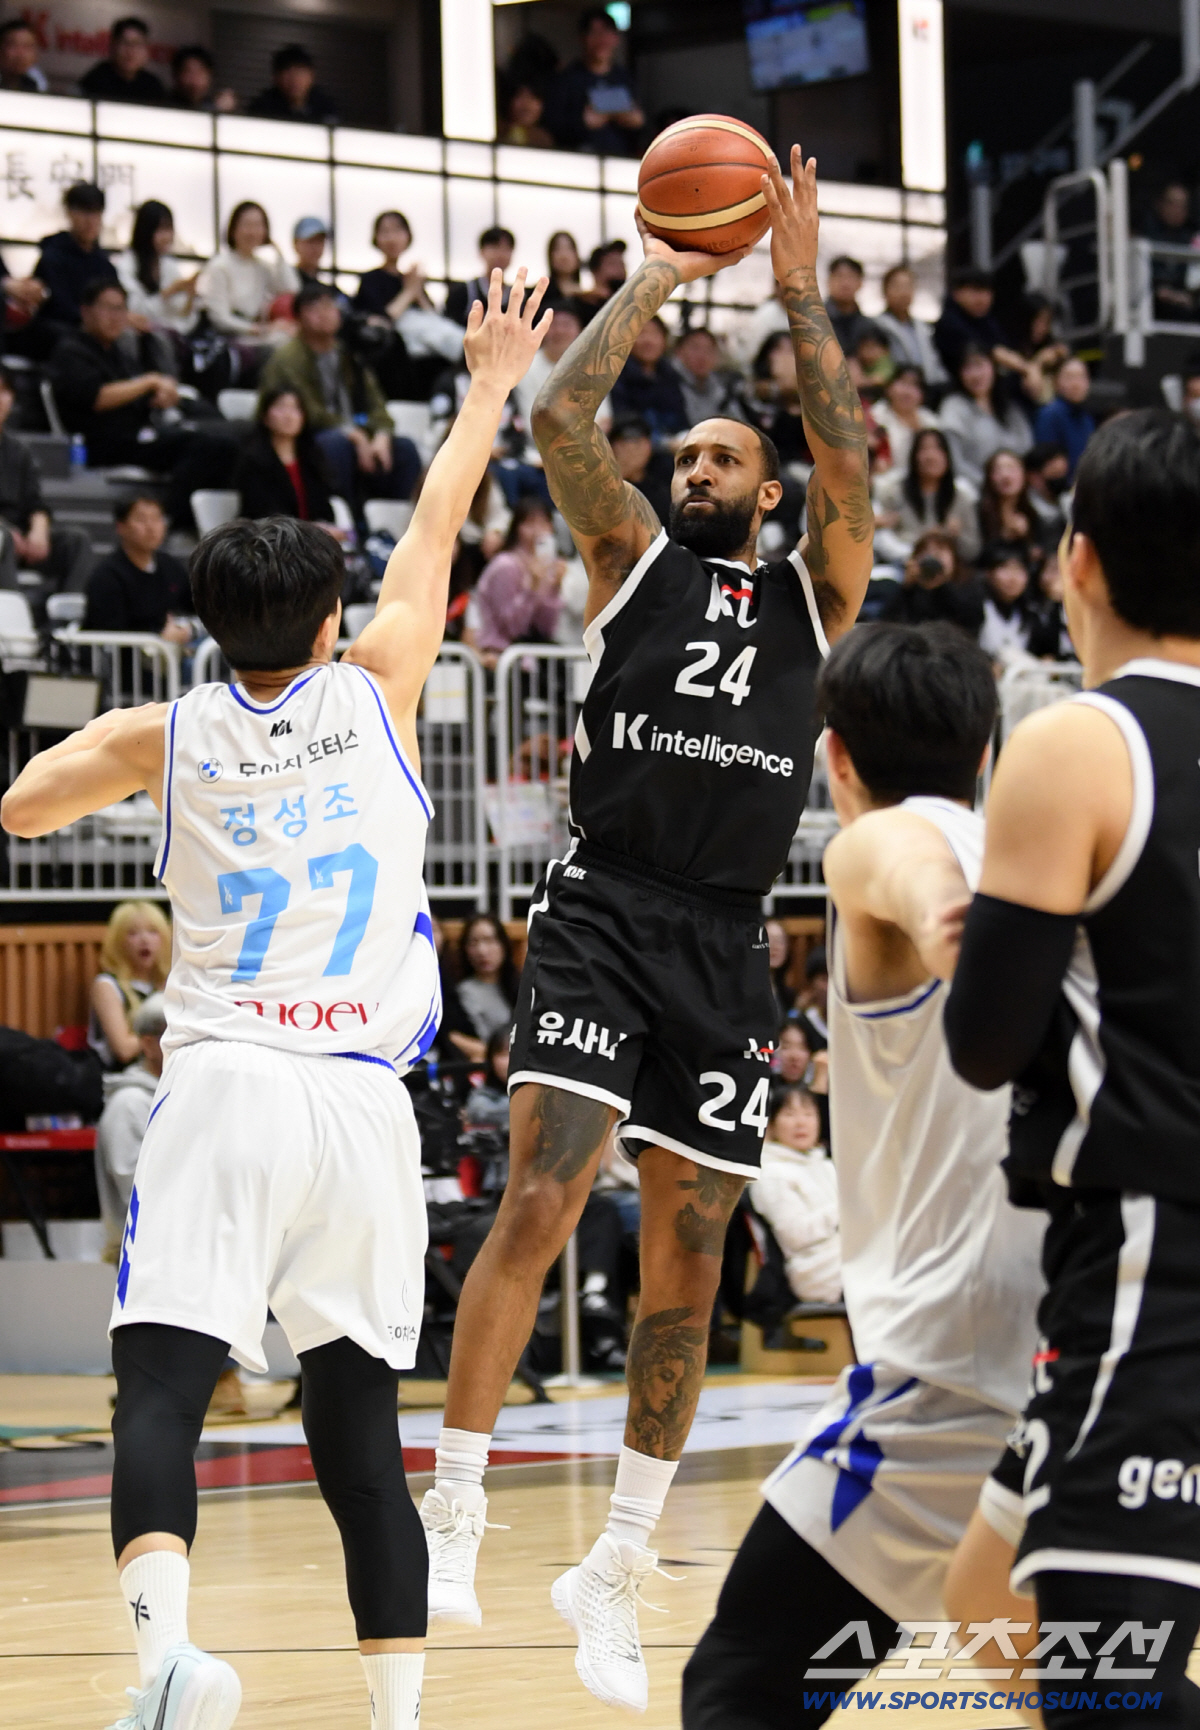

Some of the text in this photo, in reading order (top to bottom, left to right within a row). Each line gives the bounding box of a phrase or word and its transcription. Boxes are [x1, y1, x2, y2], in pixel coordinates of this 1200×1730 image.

[674, 641, 757, 706] 24
[307, 729, 359, 764] 모터스
[612, 712, 794, 777] K intelligence
[217, 843, 379, 983] 77
[698, 1071, 770, 1138] 24
